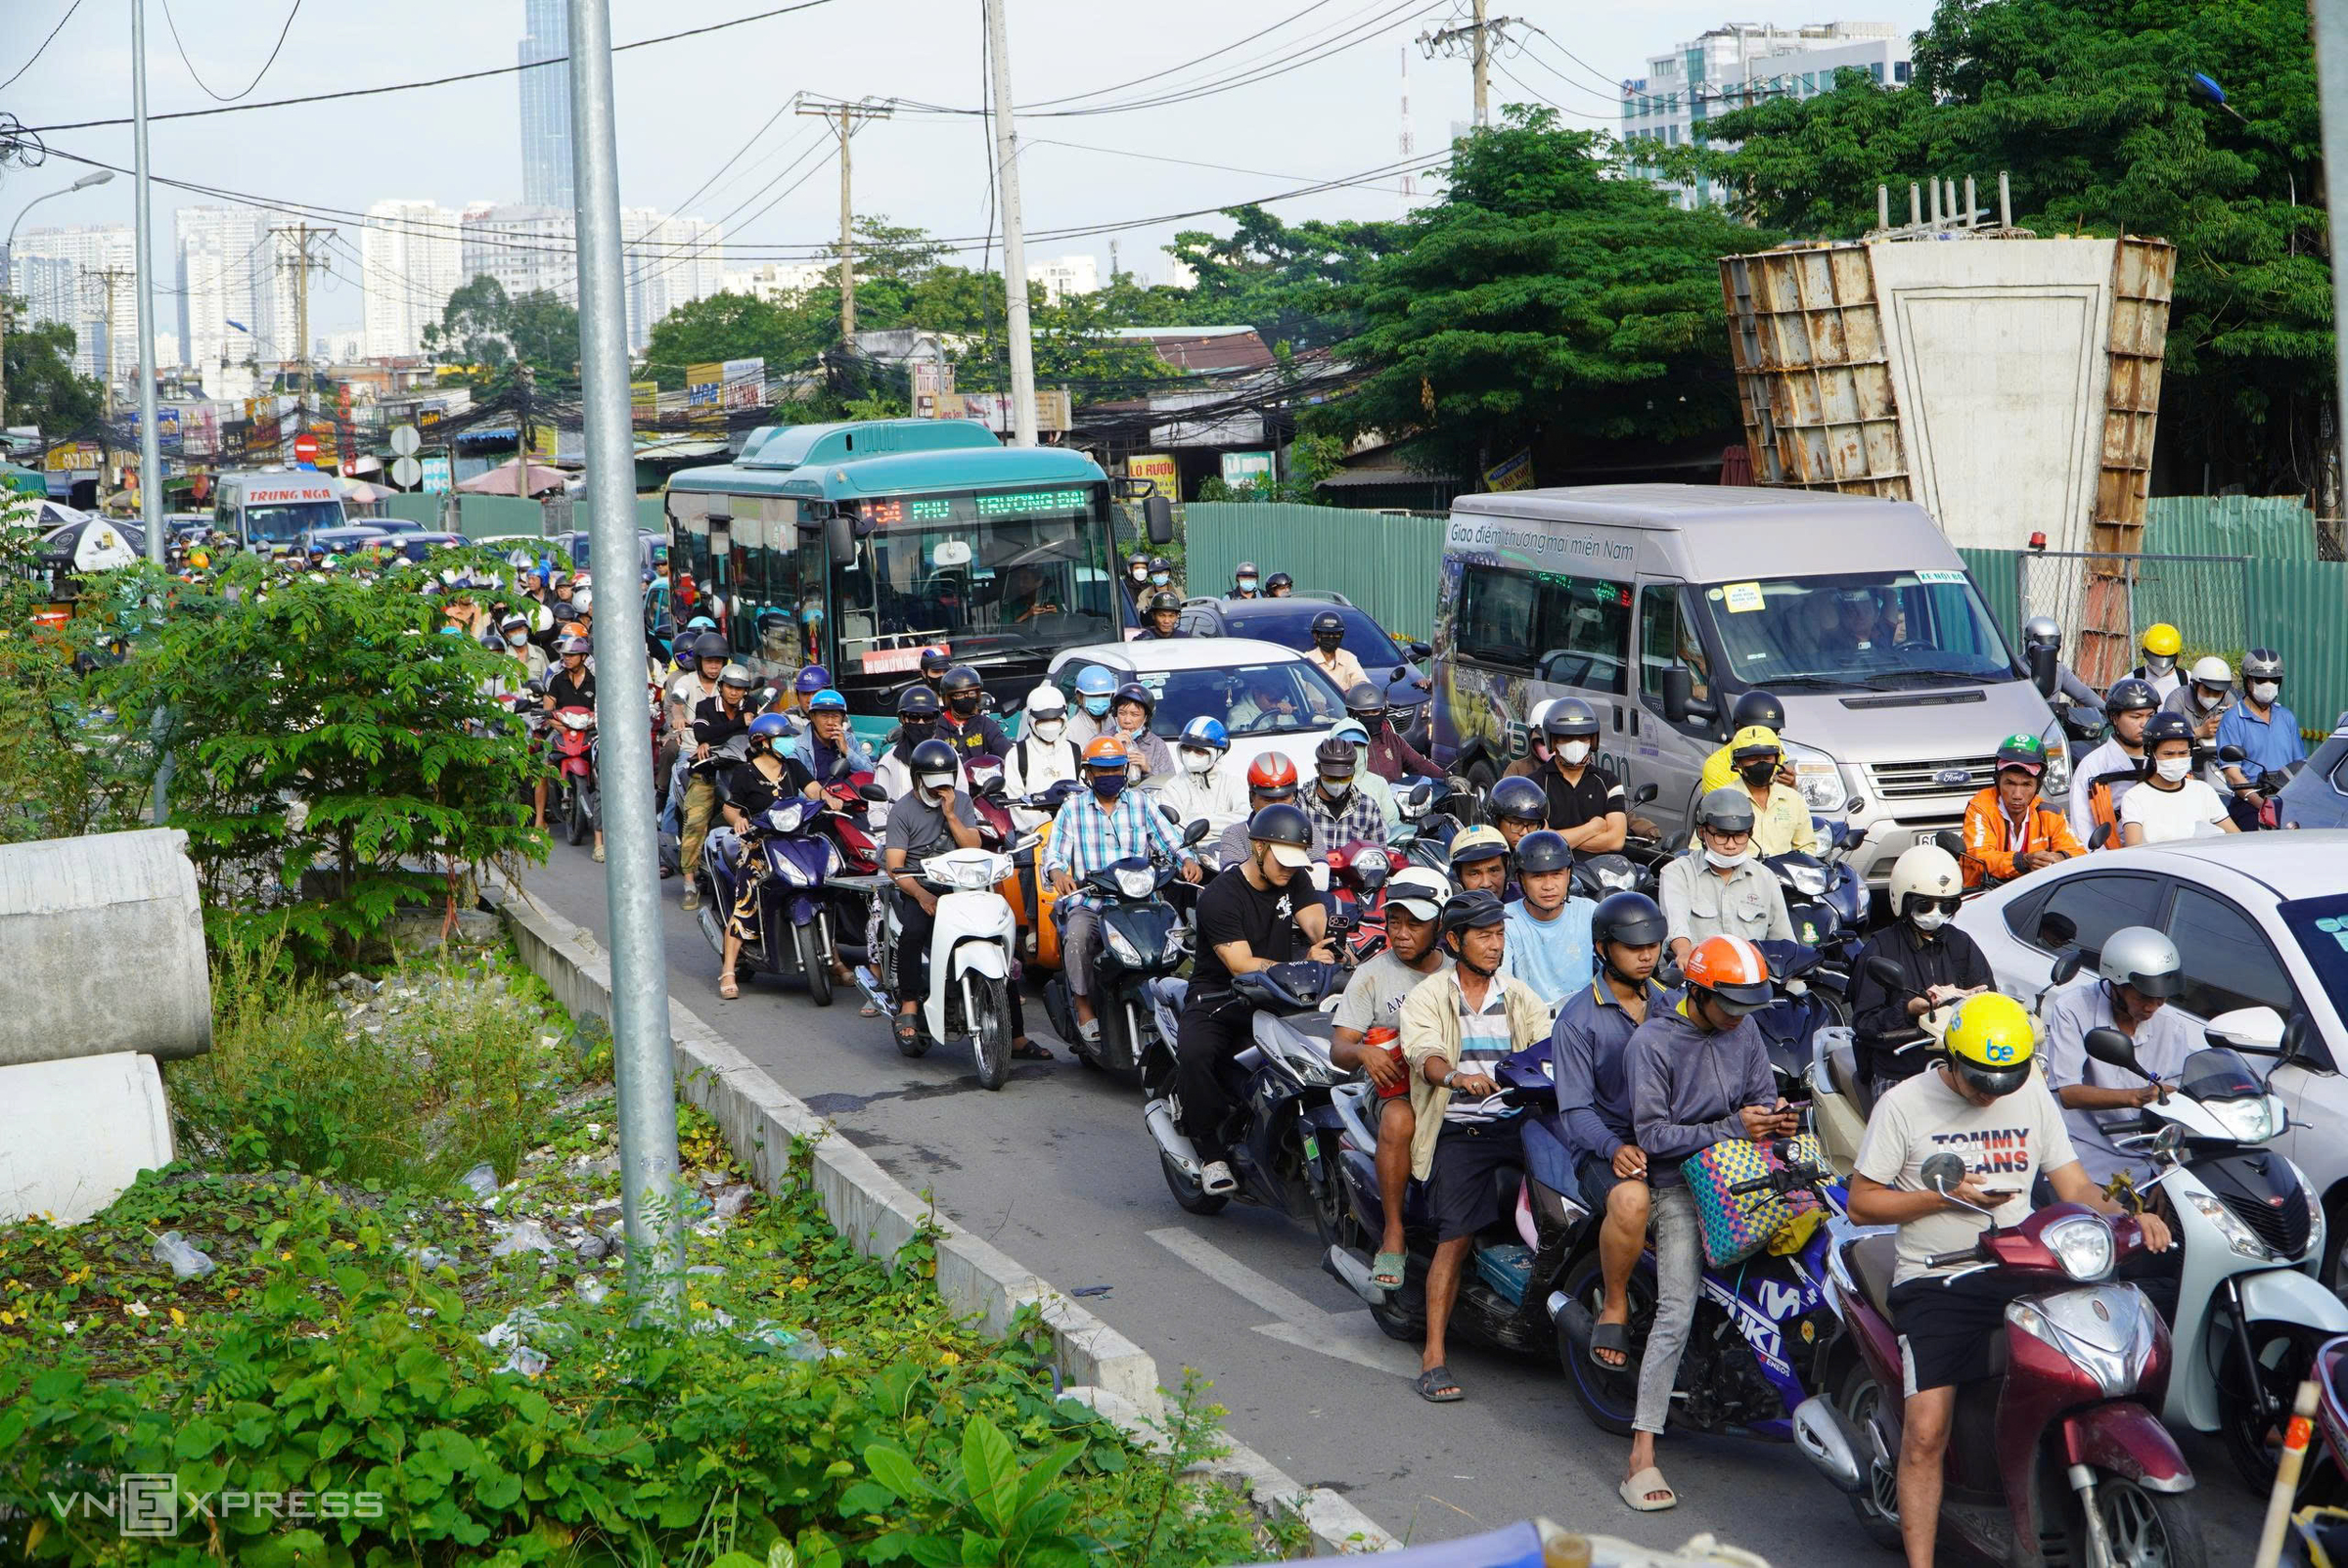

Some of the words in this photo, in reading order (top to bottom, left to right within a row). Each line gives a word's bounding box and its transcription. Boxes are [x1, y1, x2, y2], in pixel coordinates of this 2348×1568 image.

[249, 490, 298, 502] TRUNG
[301, 488, 331, 500] NGA
[1451, 523, 1473, 543] Giao
[1475, 522, 1502, 546] điểm
[1504, 527, 1546, 555] thương
[1546, 533, 1569, 558] mại
[1570, 532, 1601, 558] miền
[1603, 539, 1635, 561] Nam
[1943, 772, 1964, 783] Ford
[1986, 1039, 2014, 1061] be
[1931, 1128, 2030, 1153] TOMMY
[1961, 1149, 2029, 1176] EANS
[1766, 1358, 1790, 1377] ENEOS
